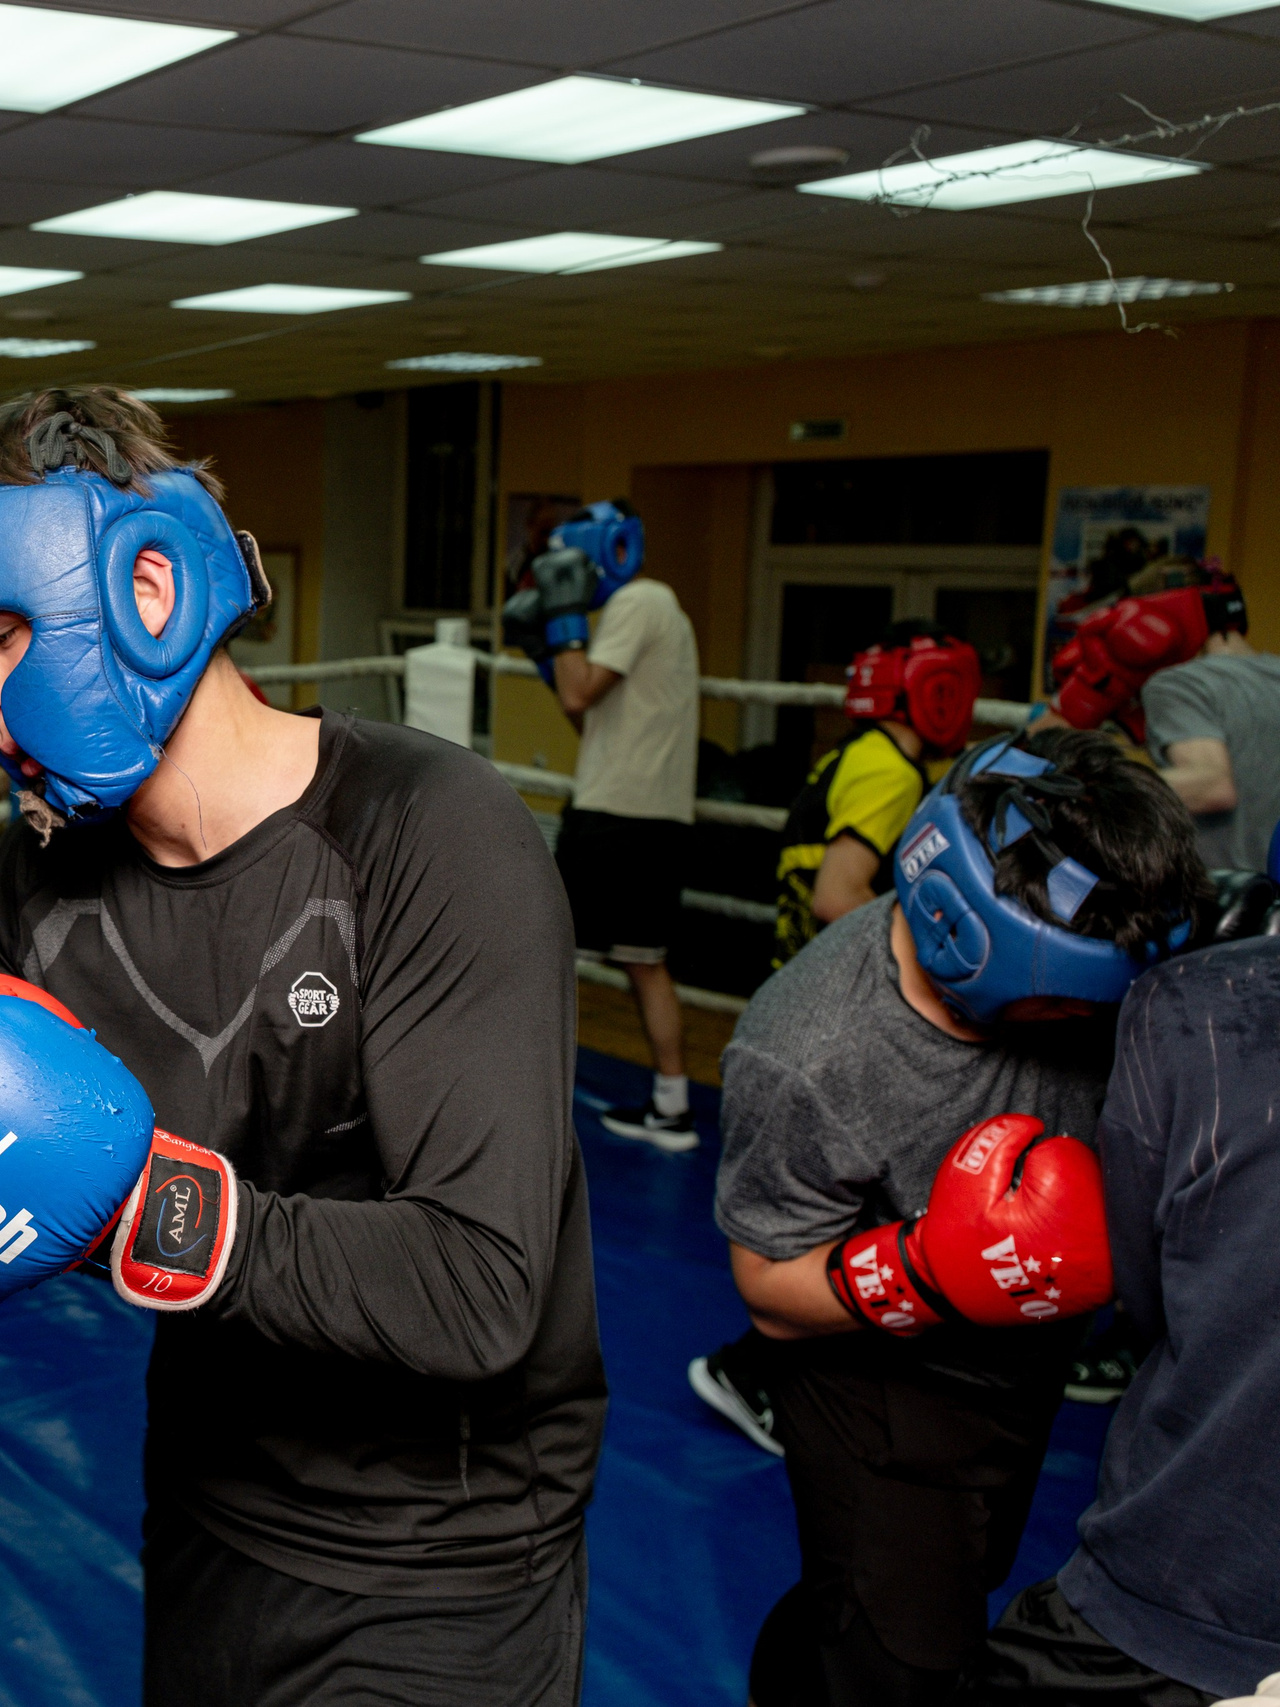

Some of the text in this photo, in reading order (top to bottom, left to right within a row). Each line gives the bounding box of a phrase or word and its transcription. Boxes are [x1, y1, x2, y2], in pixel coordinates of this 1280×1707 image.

[299, 988, 327, 1001] SPORT
[298, 1002, 328, 1015] GEAR
[153, 1129, 211, 1156] Bangkok
[142, 1271, 173, 1294] 10
[849, 1244, 916, 1328] VELO
[981, 1233, 1060, 1318] VELO
